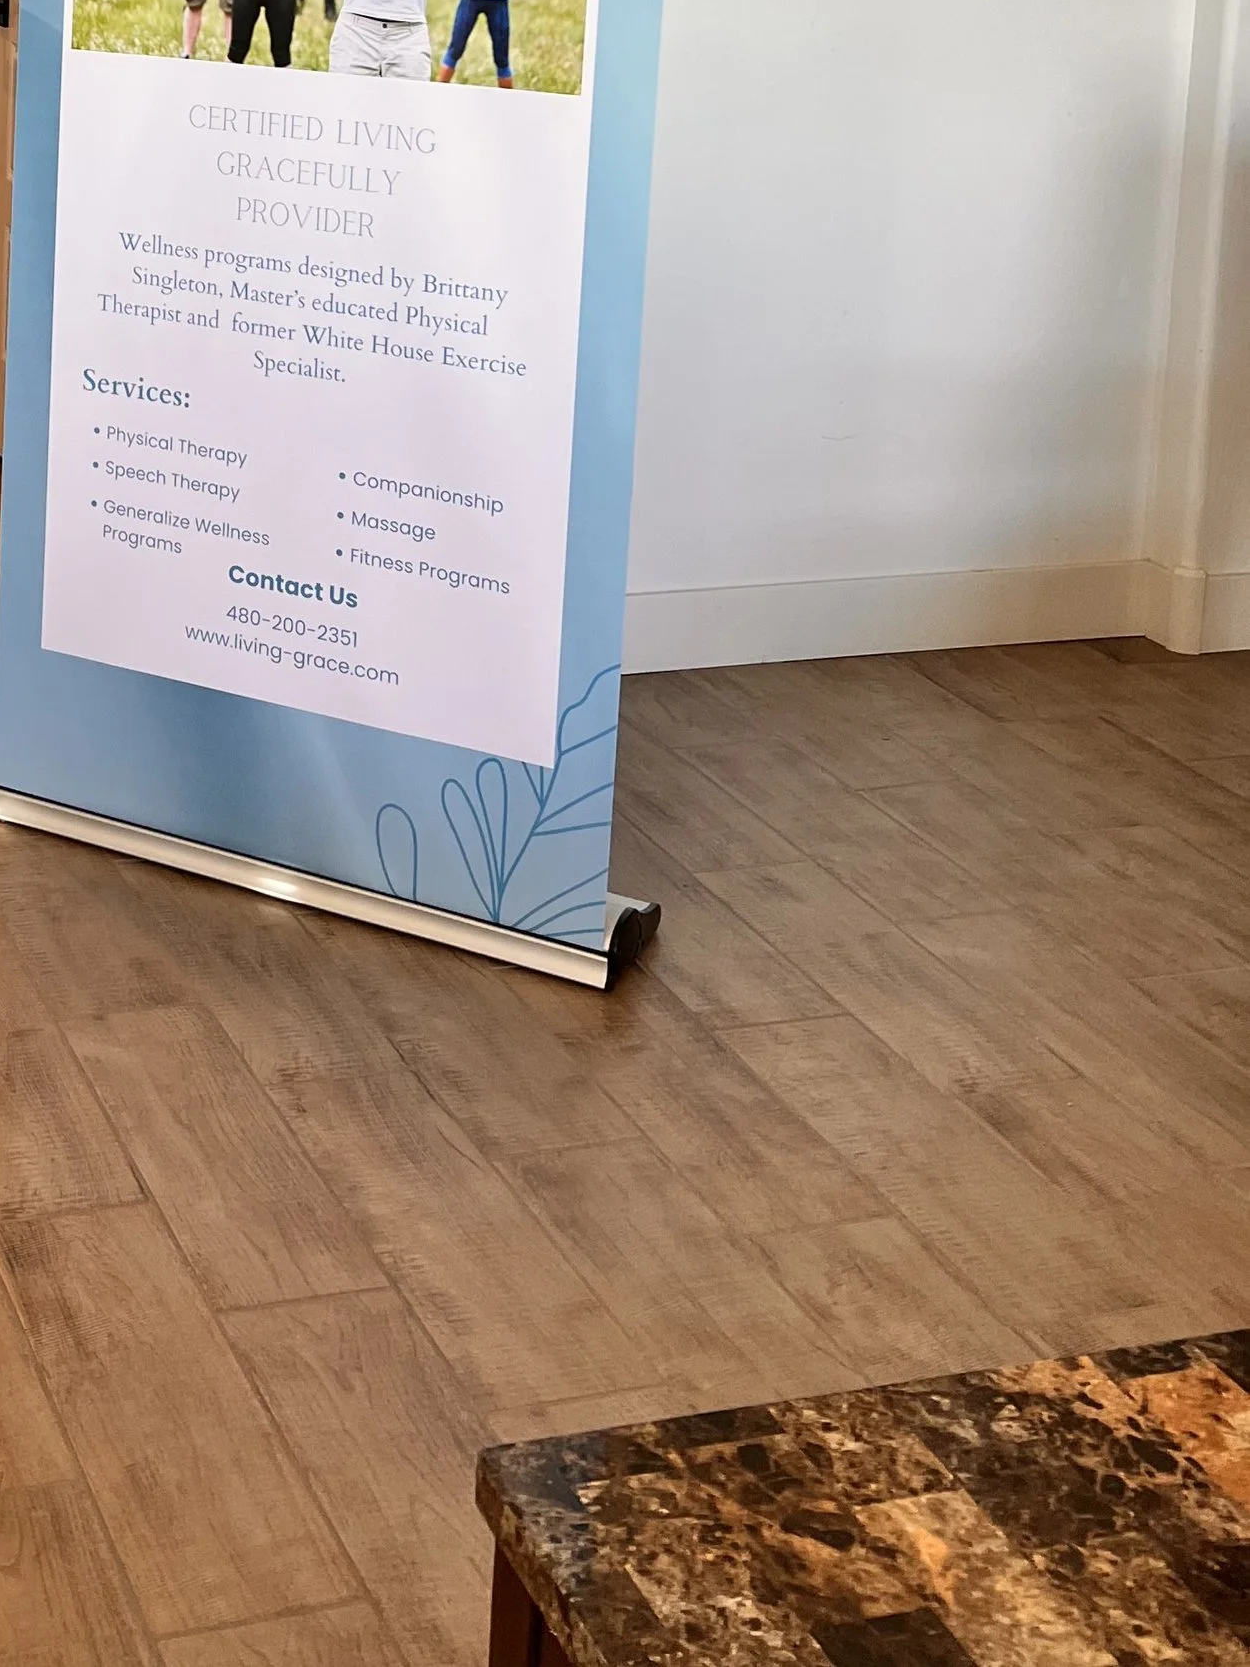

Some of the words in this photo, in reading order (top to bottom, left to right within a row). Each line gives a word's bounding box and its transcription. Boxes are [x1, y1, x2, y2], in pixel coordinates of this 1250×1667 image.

[188, 104, 324, 141] CERTIFIED
[336, 119, 437, 154] LIVING
[216, 150, 402, 196] GRACEFULLY
[236, 196, 374, 239] PROVIDER
[118, 231, 199, 260] Wellness
[204, 249, 292, 274] programs
[297, 254, 384, 288] designed
[390, 266, 415, 298] by
[422, 273, 509, 310] Brittany
[132, 266, 224, 299] Singleton,
[311, 292, 399, 323] educated
[405, 305, 488, 337] Physical
[96, 293, 183, 326] Therapist
[186, 308, 220, 329] and
[231, 311, 297, 341] former
[302, 324, 364, 352] White
[371, 334, 434, 363] House
[441, 345, 527, 377] Exercise
[82, 368, 191, 409] Services:
[253, 350, 346, 383] Specialist.
[106, 425, 174, 452] Physical
[178, 438, 248, 470] Therapy
[105, 460, 166, 486] Speech
[171, 472, 241, 504] Therapy
[353, 471, 504, 517] Companionship
[102, 523, 182, 554] Programs
[103, 499, 191, 530] Generalize
[194, 517, 270, 546] Wellness
[351, 510, 436, 543] Massage
[228, 565, 324, 602] Contact
[329, 584, 358, 609] Us
[350, 547, 414, 574] Fitness
[419, 561, 510, 595] Programs
[225, 605, 358, 648] 480-200-2351
[184, 625, 399, 686] www.living-grace.com
